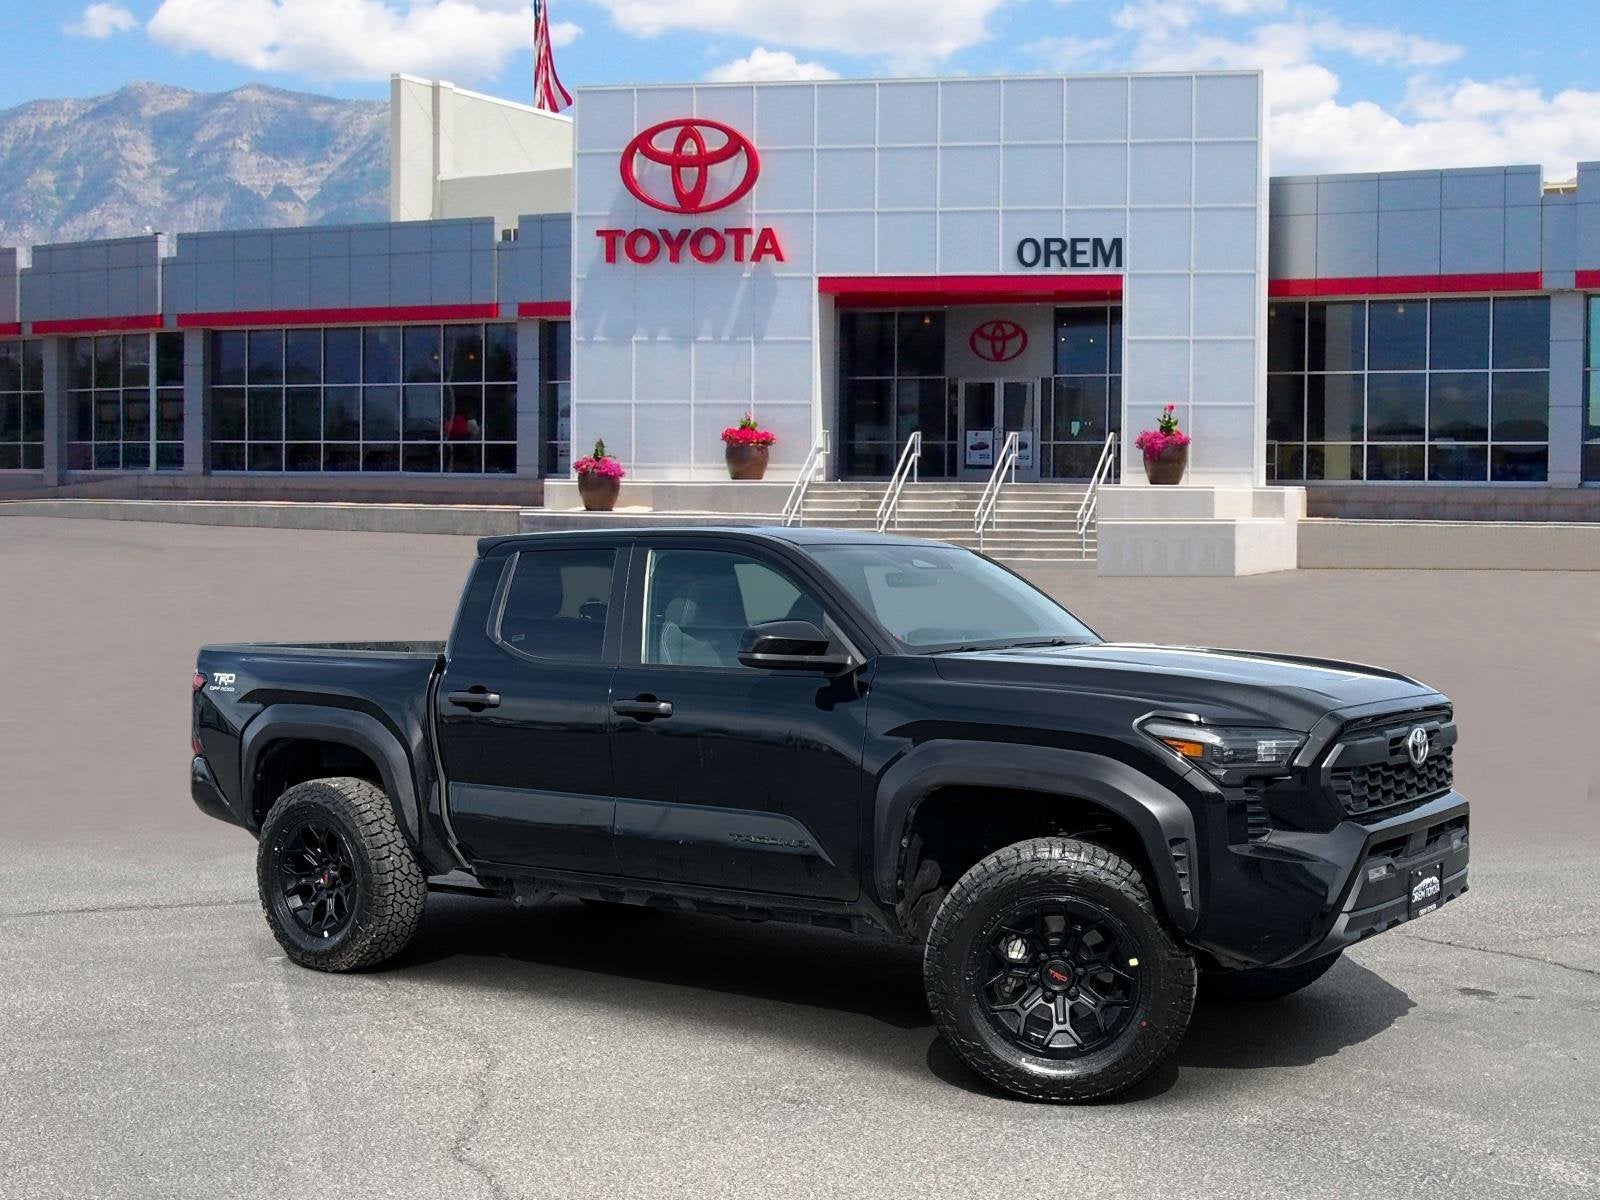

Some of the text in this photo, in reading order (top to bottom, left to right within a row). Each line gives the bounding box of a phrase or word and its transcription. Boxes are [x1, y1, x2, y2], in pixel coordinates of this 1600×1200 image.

[596, 227, 784, 264] TOYOTA
[1016, 237, 1123, 268] OREM
[213, 672, 235, 685] TRD
